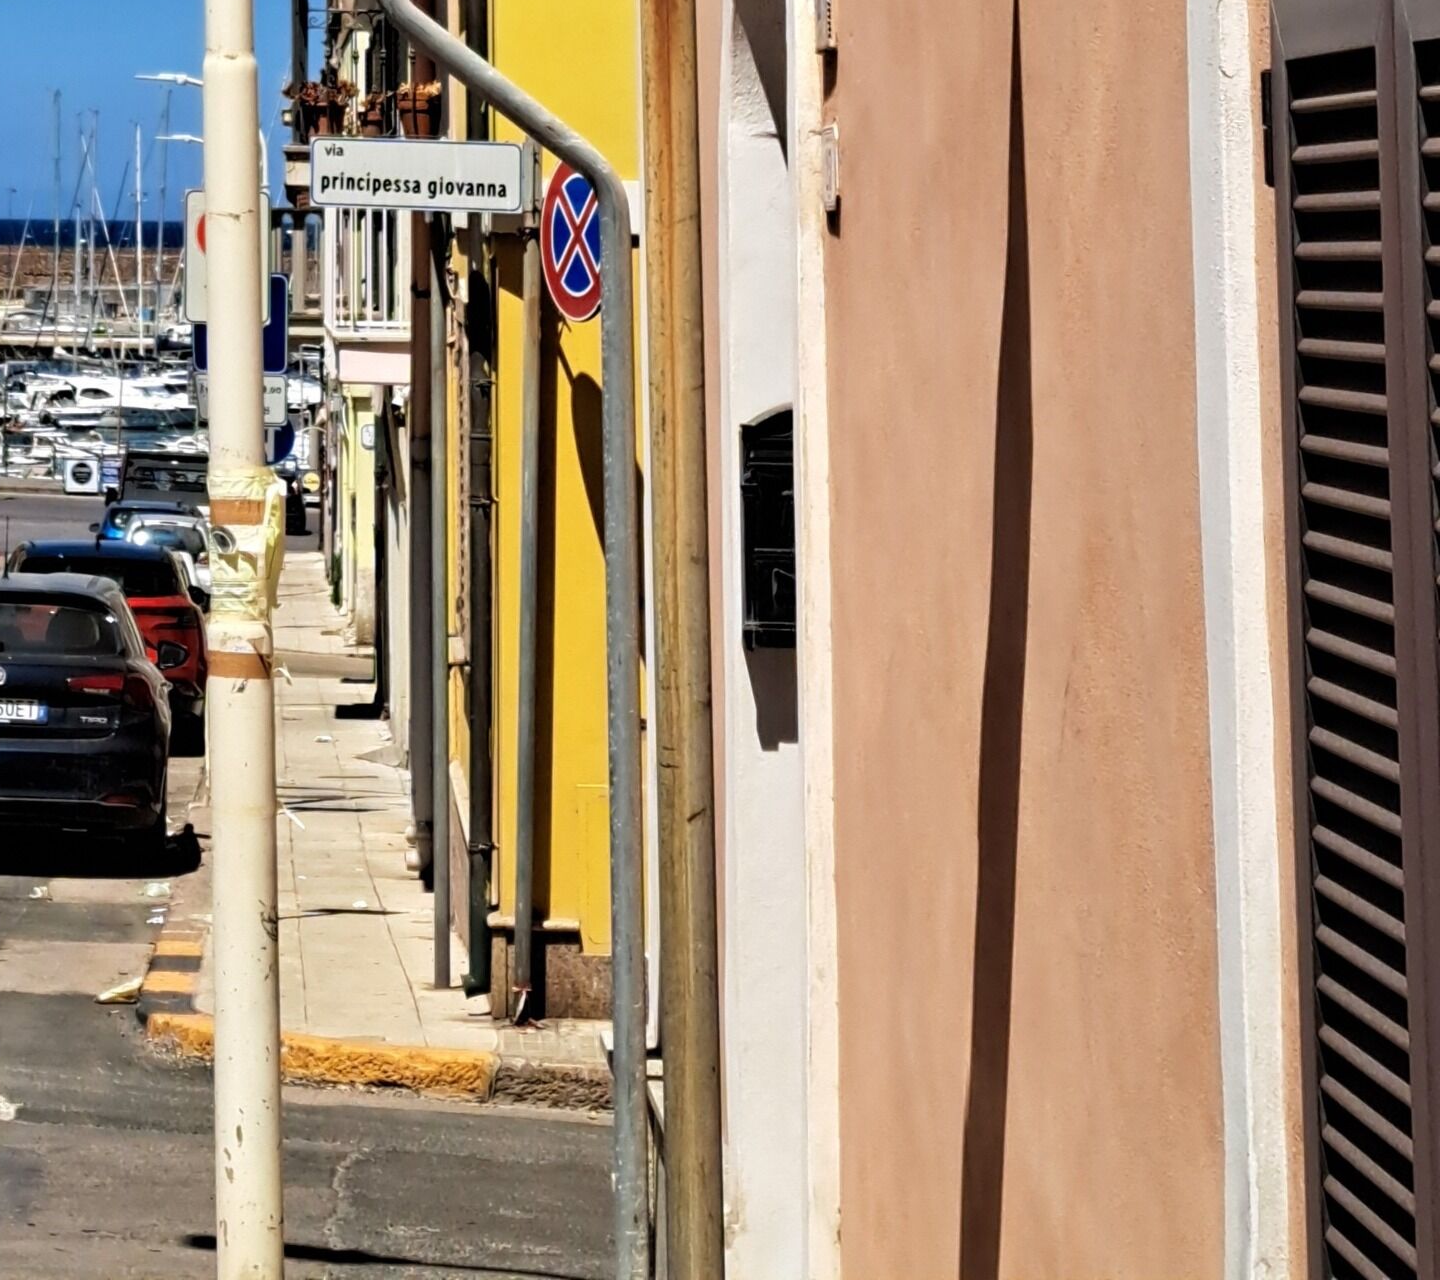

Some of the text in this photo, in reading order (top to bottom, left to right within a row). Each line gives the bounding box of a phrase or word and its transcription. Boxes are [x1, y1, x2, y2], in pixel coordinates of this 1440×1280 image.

[324, 143, 344, 157] via
[321, 172, 507, 200] principessa giovanna
